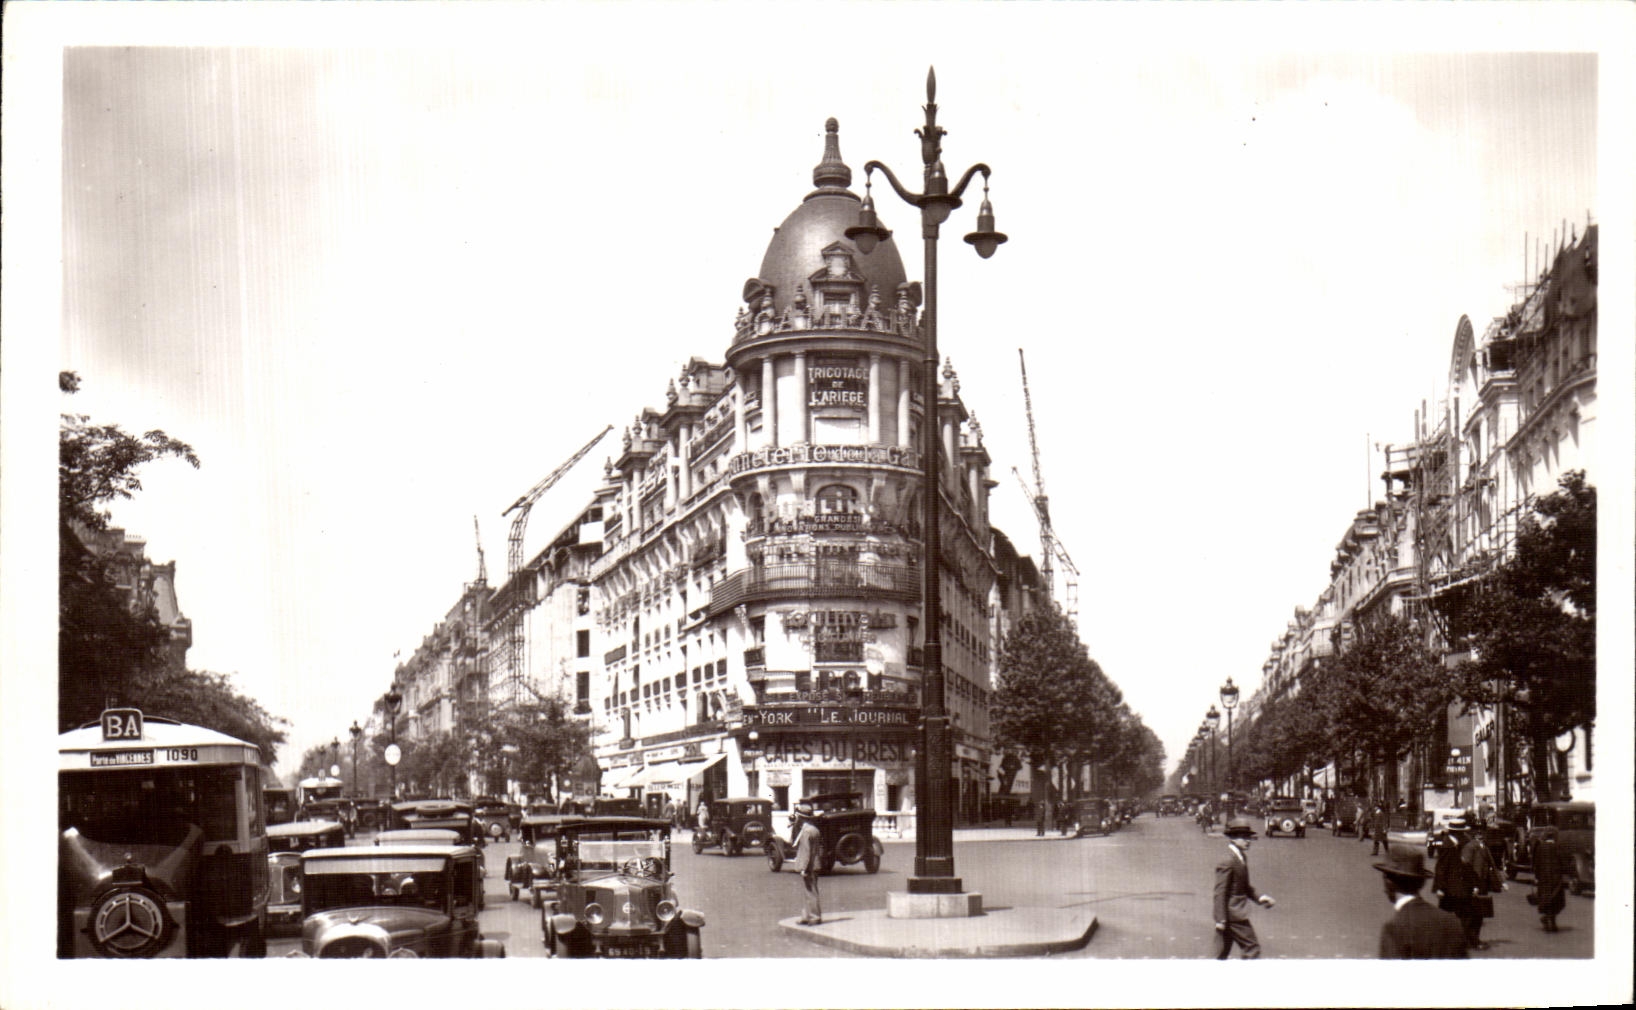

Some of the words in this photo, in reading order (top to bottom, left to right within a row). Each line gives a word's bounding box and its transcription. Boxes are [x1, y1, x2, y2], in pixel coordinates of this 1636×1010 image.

[807, 367, 870, 380] TRICOTAGE
[831, 380, 844, 388] DE
[811, 391, 864, 403] L'ARIEGE
[849, 709, 909, 725] JOURNAL
[106, 715, 140, 738] BA
[166, 748, 198, 761] 1090
[822, 741, 849, 763] DU
